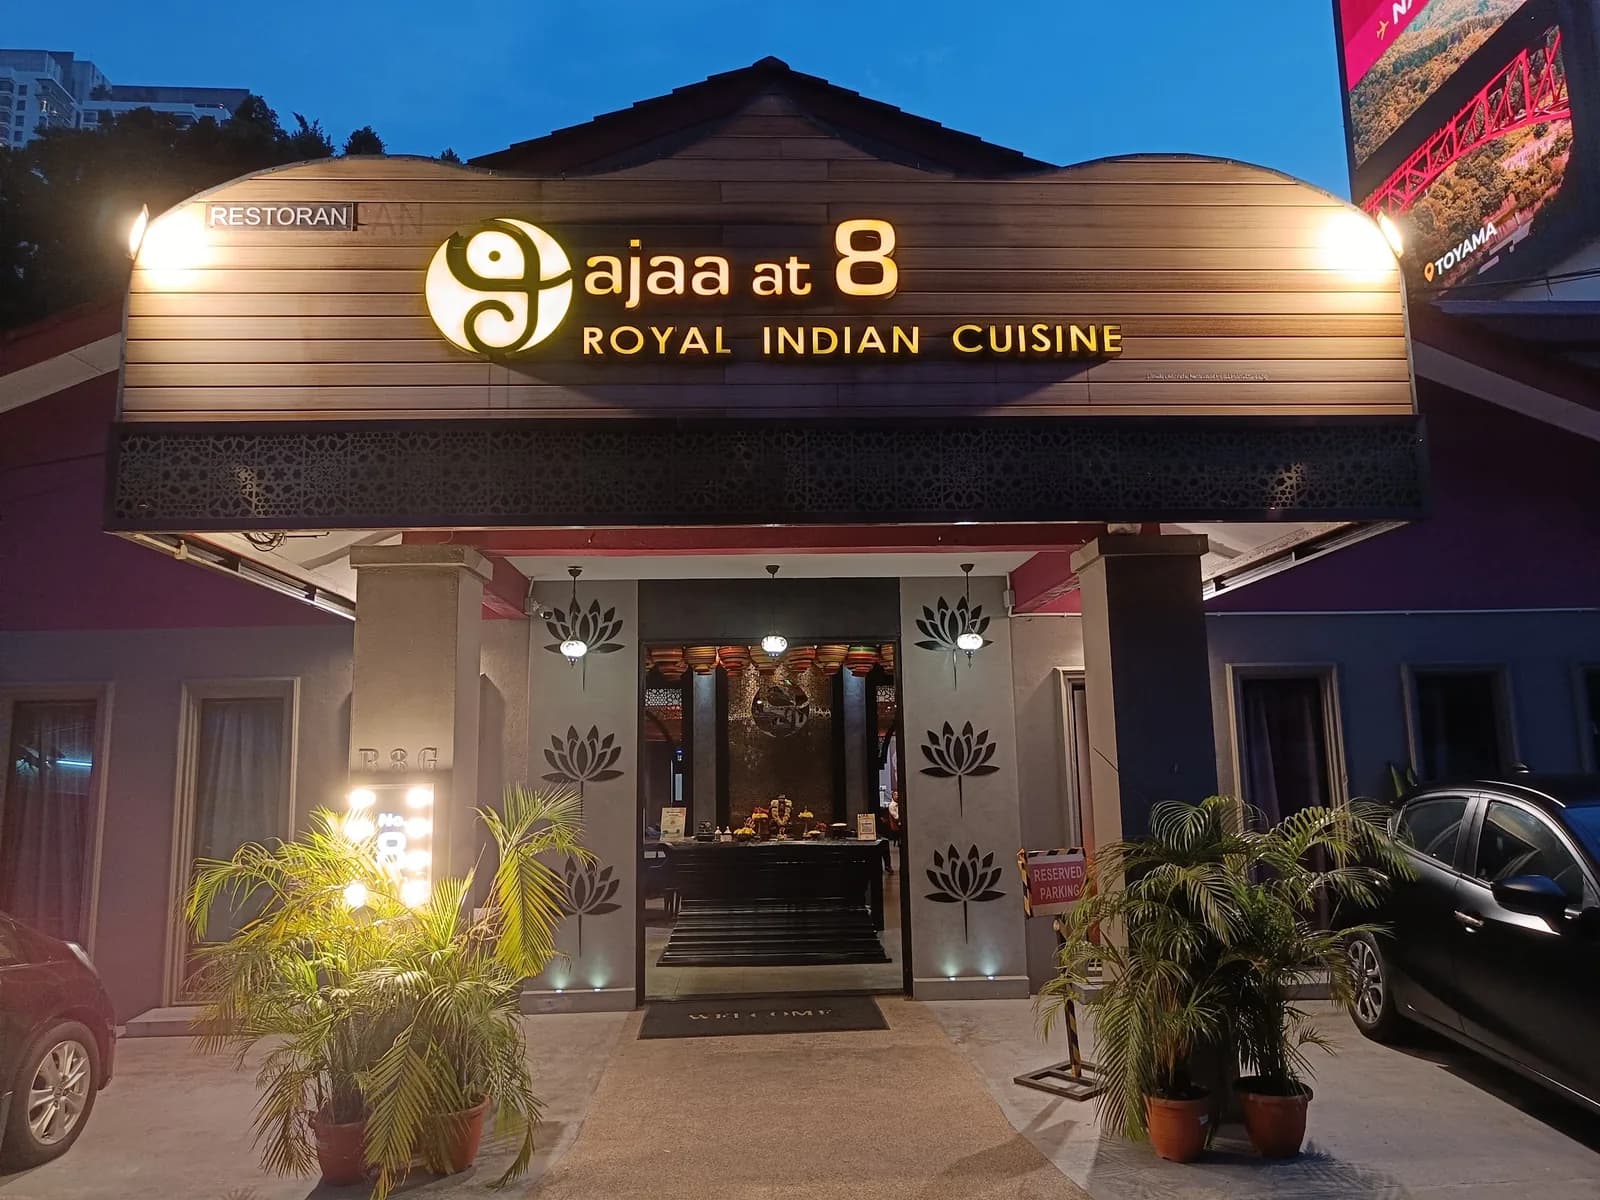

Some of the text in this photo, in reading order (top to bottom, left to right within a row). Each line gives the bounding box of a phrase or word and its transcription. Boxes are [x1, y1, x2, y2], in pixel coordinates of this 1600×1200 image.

[210, 207, 347, 226] RESTORAN
[1434, 221, 1498, 275] TOYAMA
[584, 219, 899, 310] ajaa at 8
[581, 323, 1123, 355] ROYAL INDIAN CUISINE
[1033, 866, 1082, 882] RESERVED
[1040, 884, 1080, 900] PARKING
